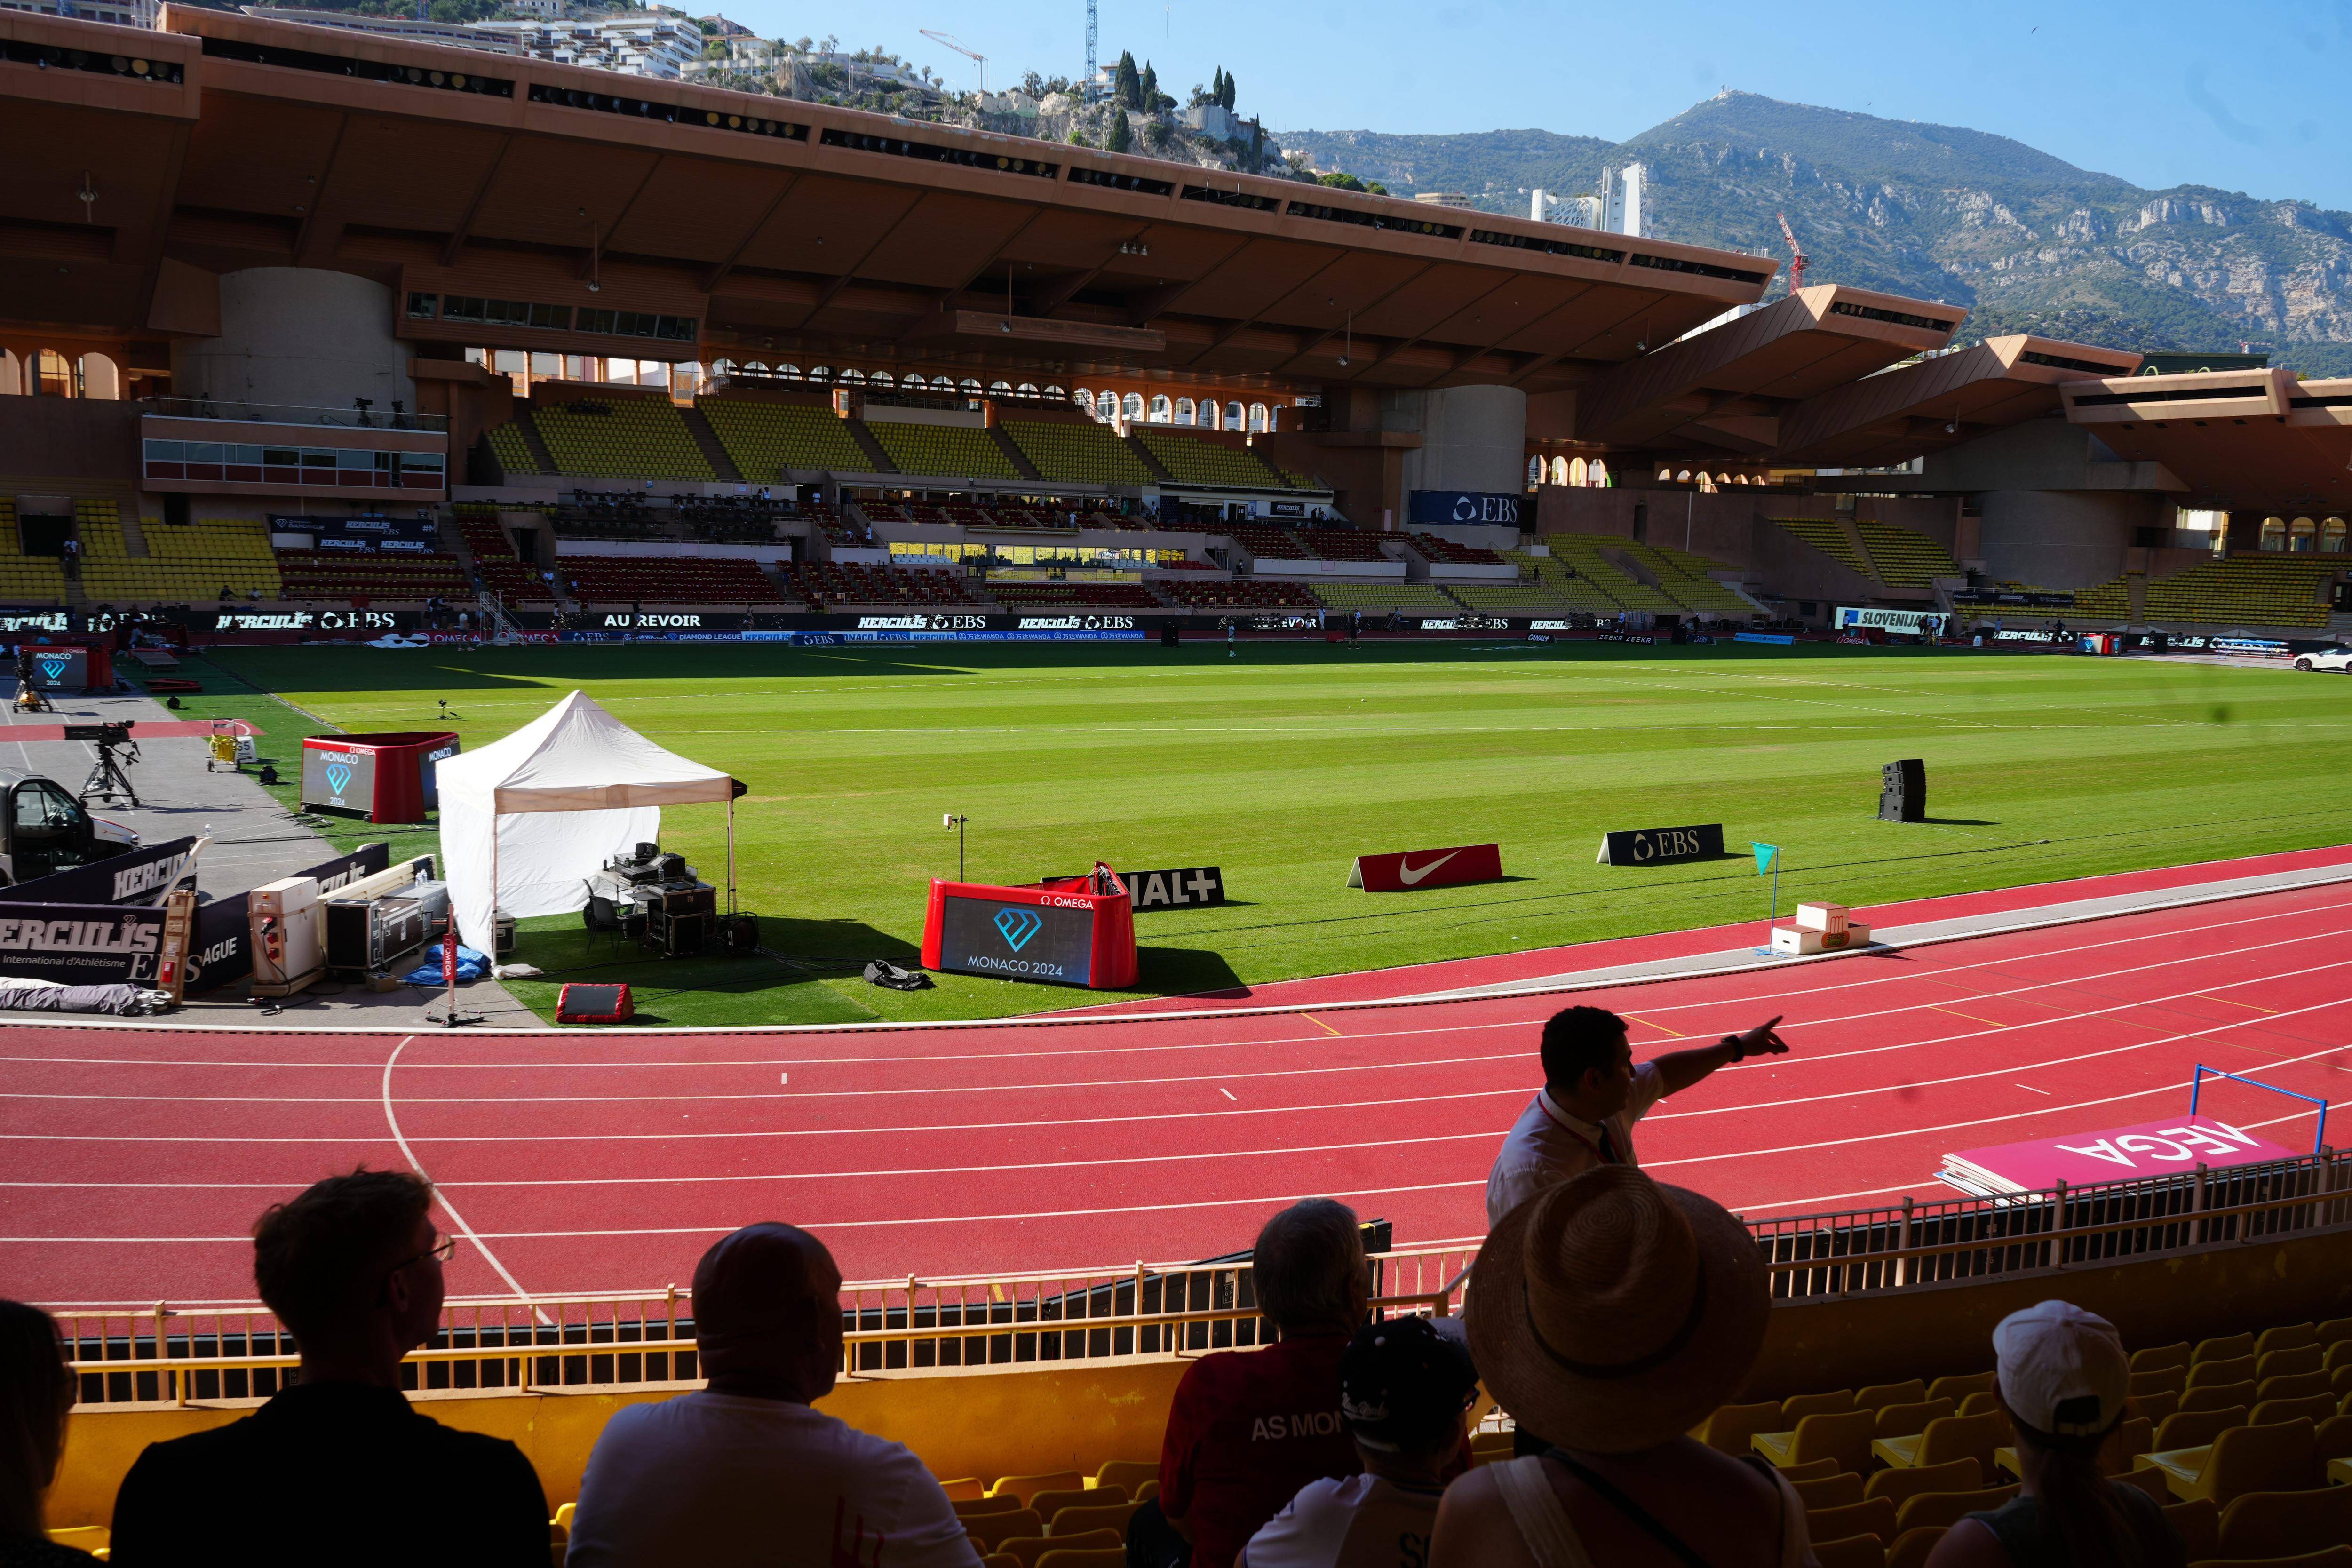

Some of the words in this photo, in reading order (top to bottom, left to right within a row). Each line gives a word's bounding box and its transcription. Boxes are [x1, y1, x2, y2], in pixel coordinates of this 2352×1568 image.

[1480, 497, 1518, 523] EBS
[604, 614, 630, 627] AU
[858, 613, 928, 629] HERCULIS
[952, 615, 986, 628] EBS
[1018, 614, 1081, 629] HERCULIS
[1102, 616, 1135, 629] EBS
[815, 635, 834, 644] EBS
[1528, 633, 1549, 642] CANAL+
[320, 751, 358, 764] MONACO
[429, 747, 452, 762] MONACO
[329, 796, 346, 806] 2024
[1656, 829, 1700, 857] EBS
[1054, 896, 1094, 910] OMEGA
[3, 955, 64, 966] International
[967, 955, 1029, 973] MONACO
[1033, 962, 1063, 977] 2024
[1251, 1415, 1287, 1441] AS
